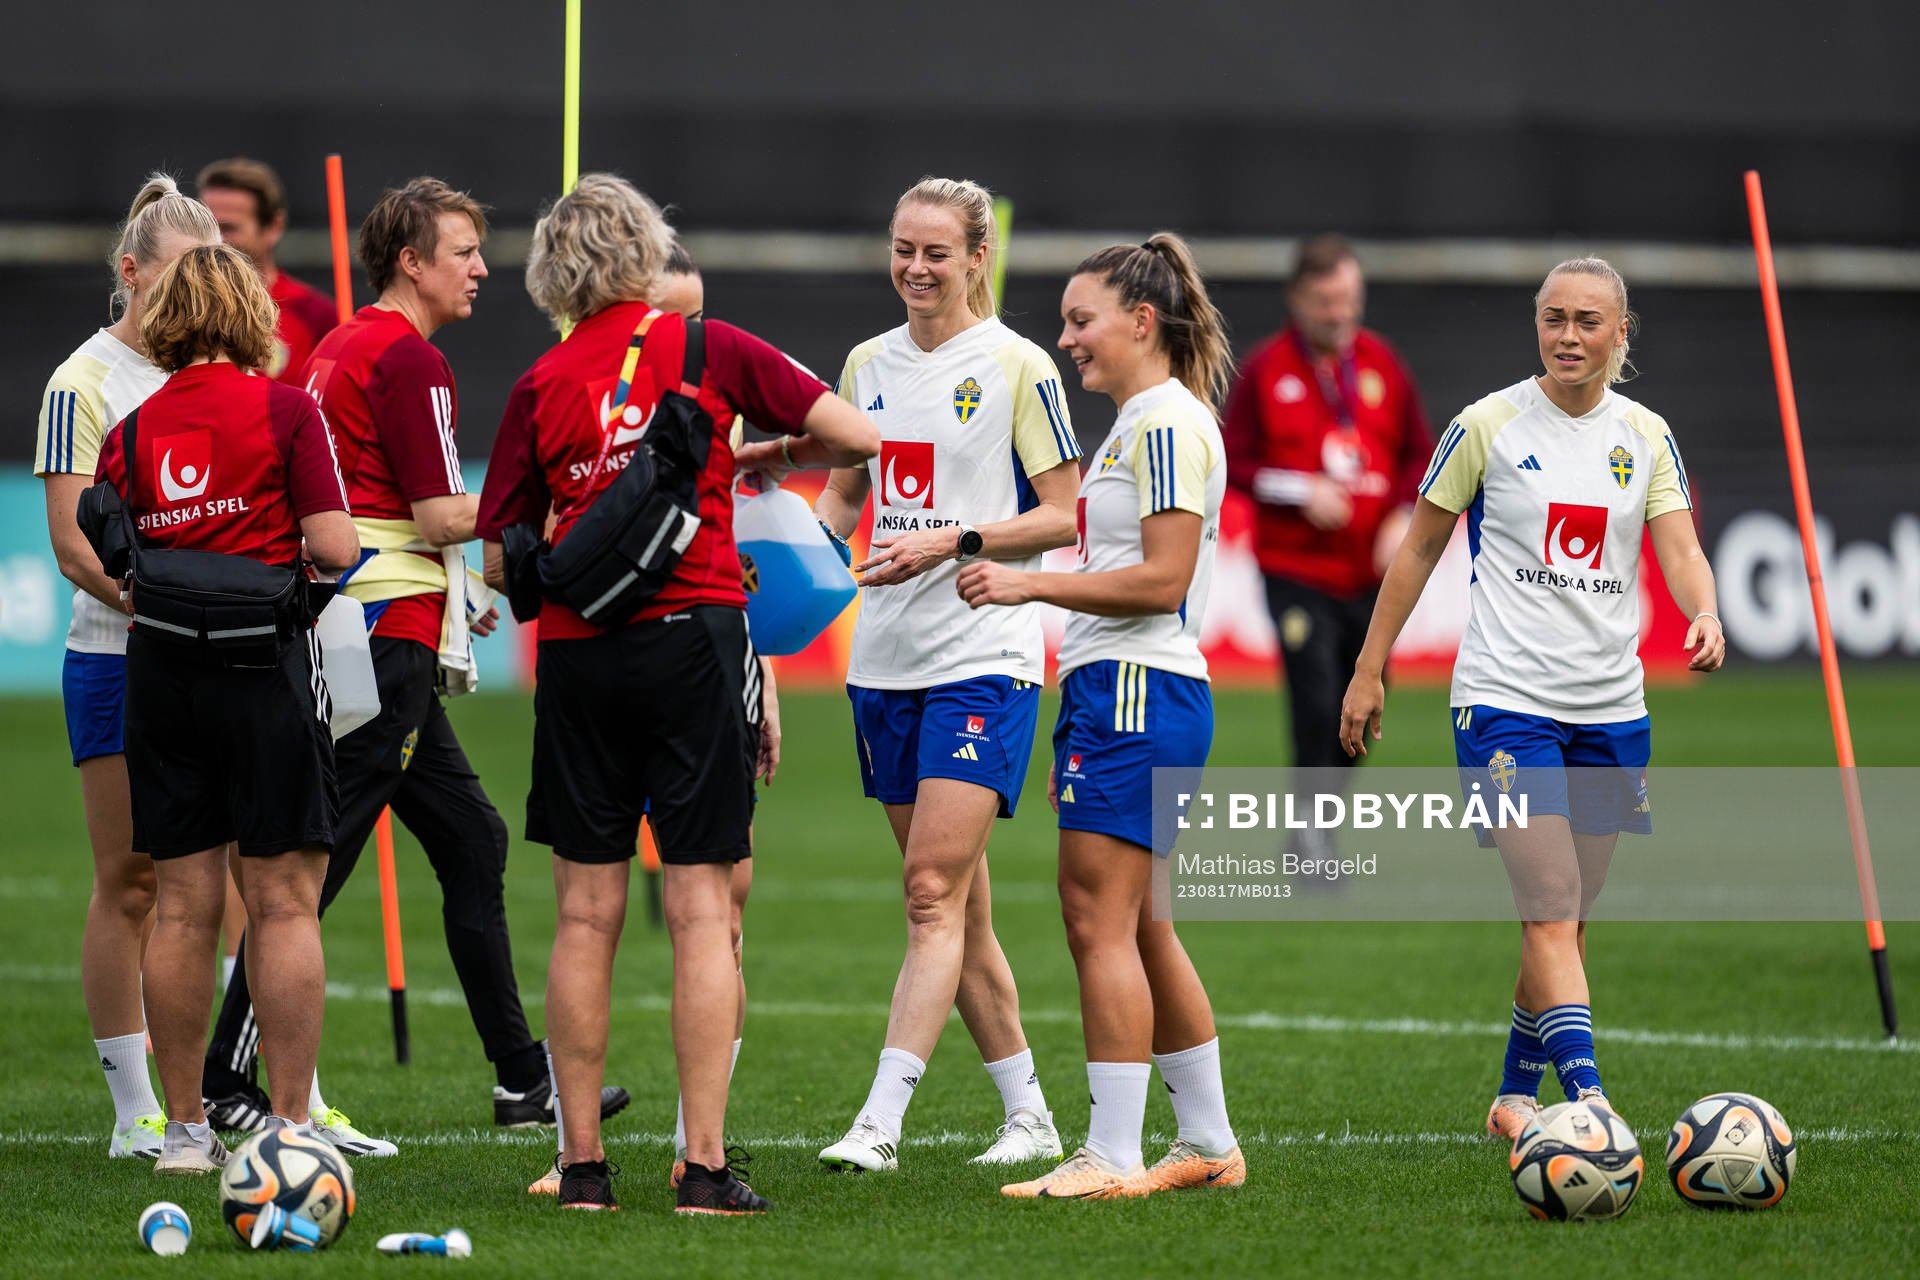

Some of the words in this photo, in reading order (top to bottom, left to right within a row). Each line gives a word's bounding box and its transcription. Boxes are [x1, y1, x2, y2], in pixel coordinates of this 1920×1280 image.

[205, 497, 249, 516] SPEL
[1514, 568, 1587, 592] SVENSKA
[1592, 579, 1624, 594] SPEL
